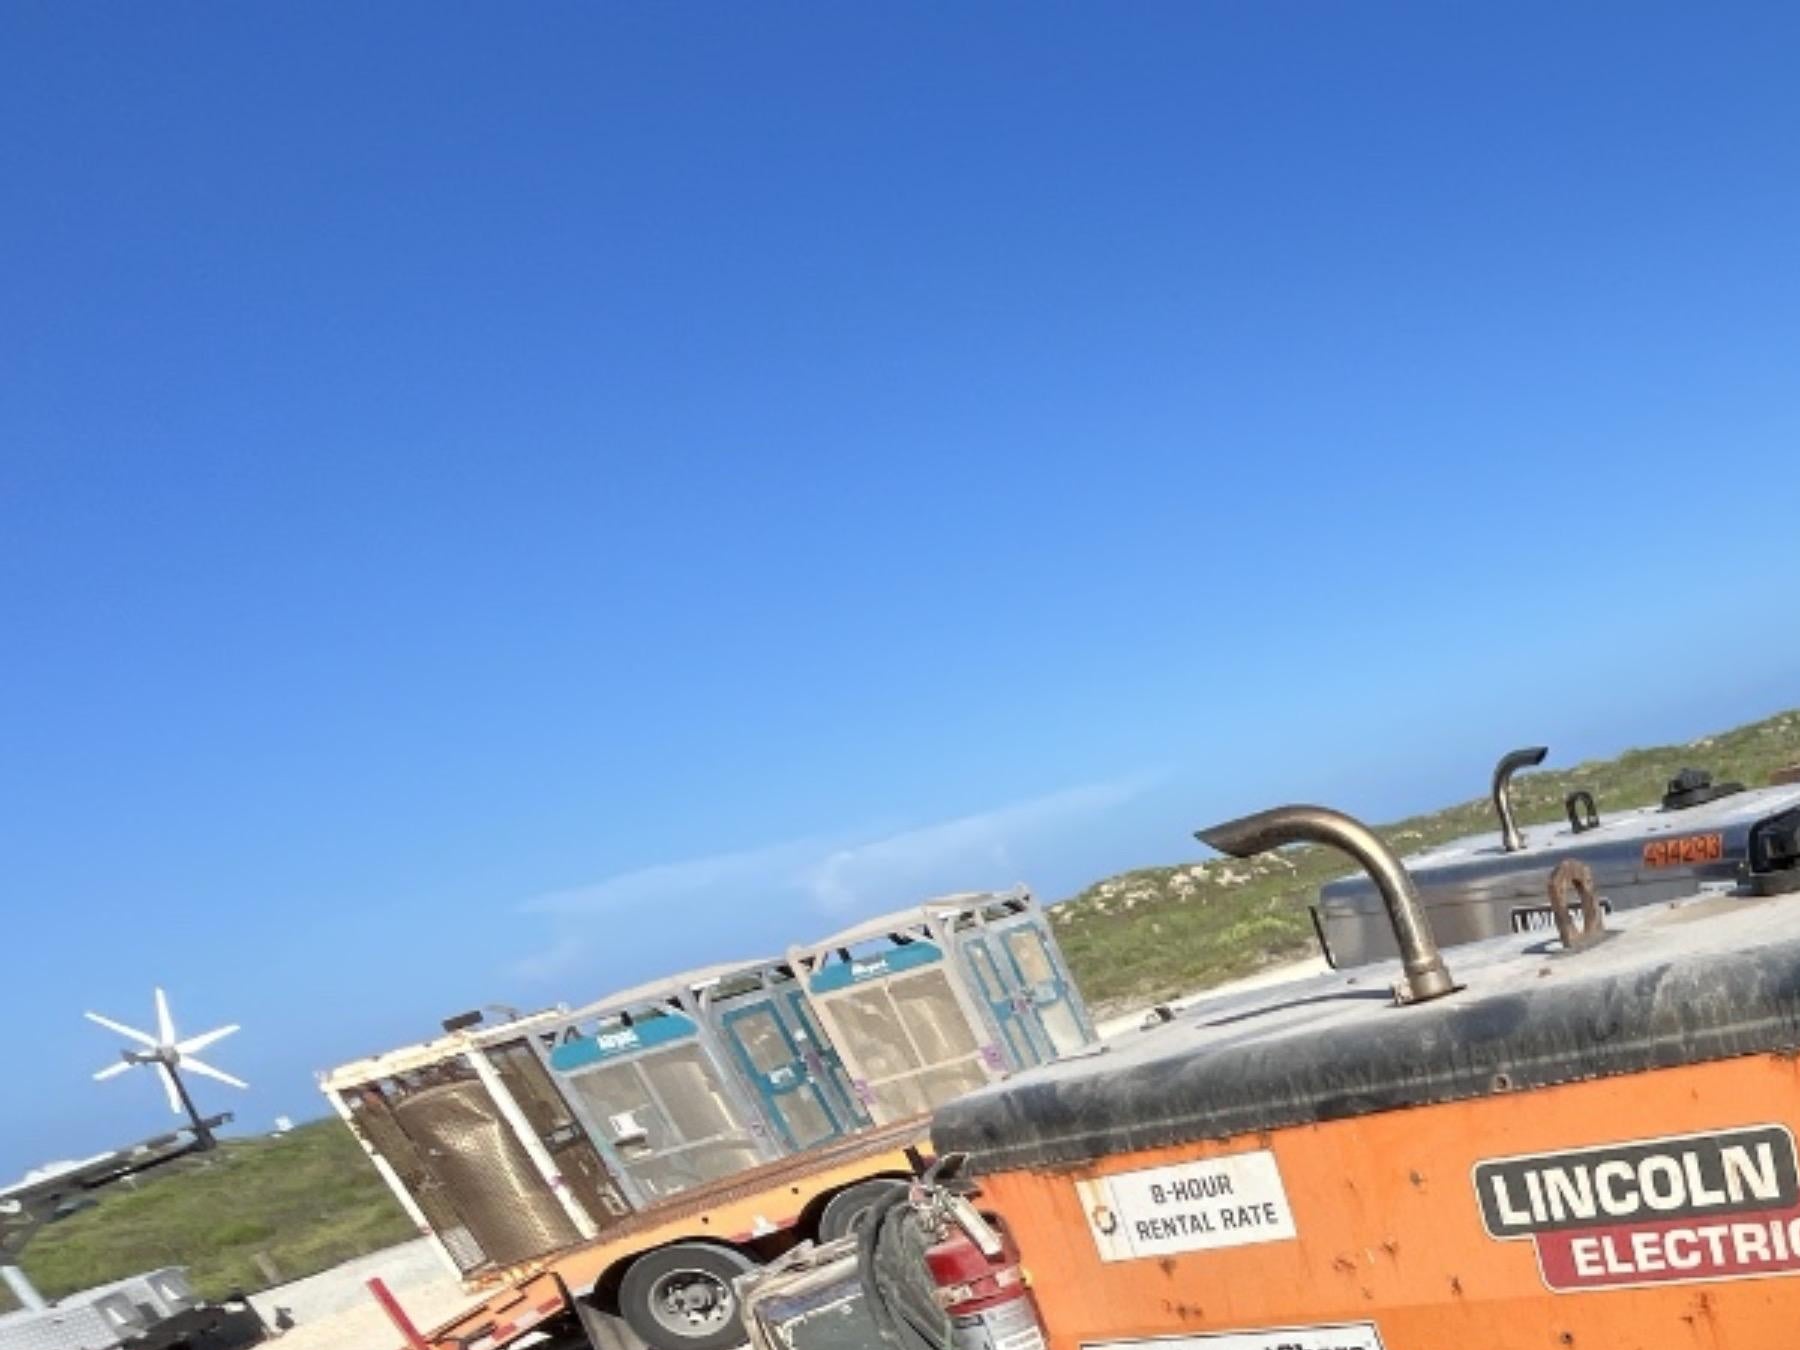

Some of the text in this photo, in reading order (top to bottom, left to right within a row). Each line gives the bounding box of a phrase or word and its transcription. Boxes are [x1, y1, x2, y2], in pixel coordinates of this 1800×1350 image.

[1151, 1175, 1234, 1204] 8-HOUR
[1490, 1141, 1781, 1226] LINCOLN
[1135, 1202, 1279, 1241] RENTAL RATE
